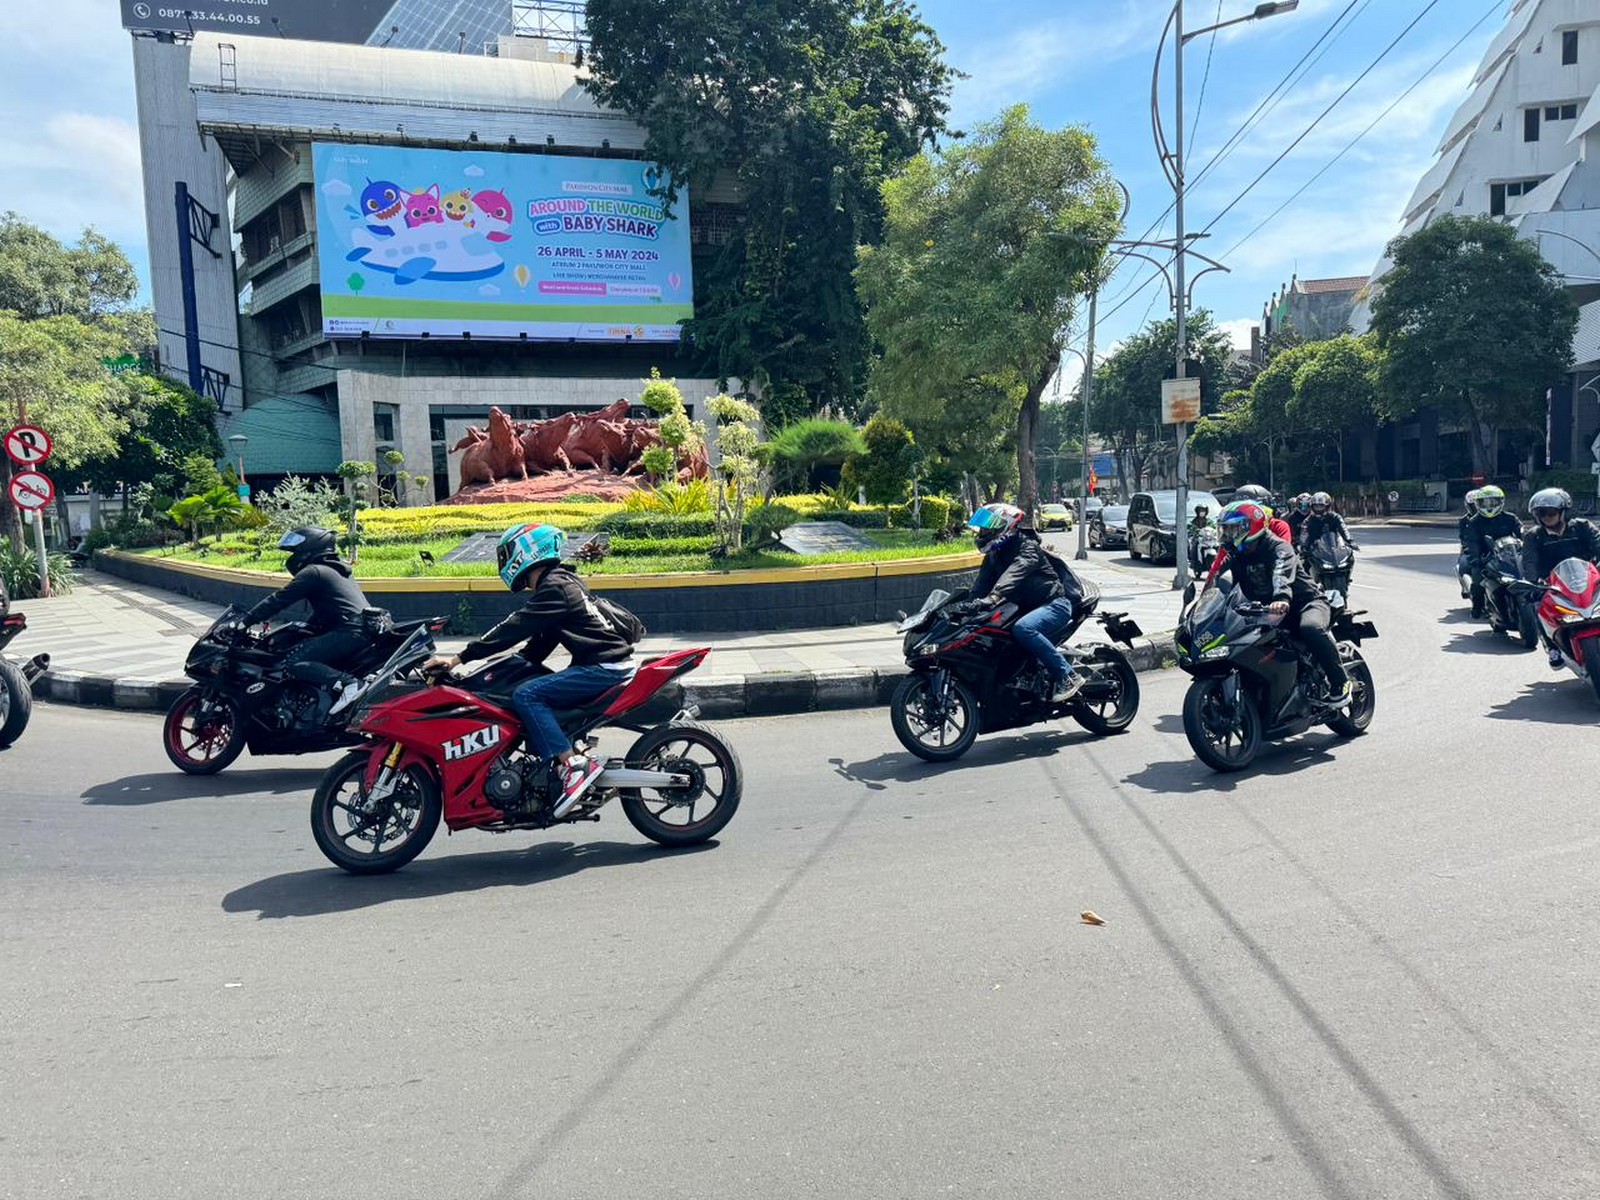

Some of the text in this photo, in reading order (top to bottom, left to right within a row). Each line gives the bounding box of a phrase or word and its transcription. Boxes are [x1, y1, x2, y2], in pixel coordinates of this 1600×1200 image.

[530, 199, 665, 221] AROUND THE WORLD
[538, 216, 657, 238] with BABY SHARK
[538, 246, 552, 257] 26
[554, 247, 586, 258] APRIL
[596, 248, 603, 259] 5
[605, 249, 628, 260] MAY
[632, 250, 659, 261] 2024
[18, 432, 36, 458] P
[507, 550, 525, 577] KYT
[442, 724, 500, 761] HKU
